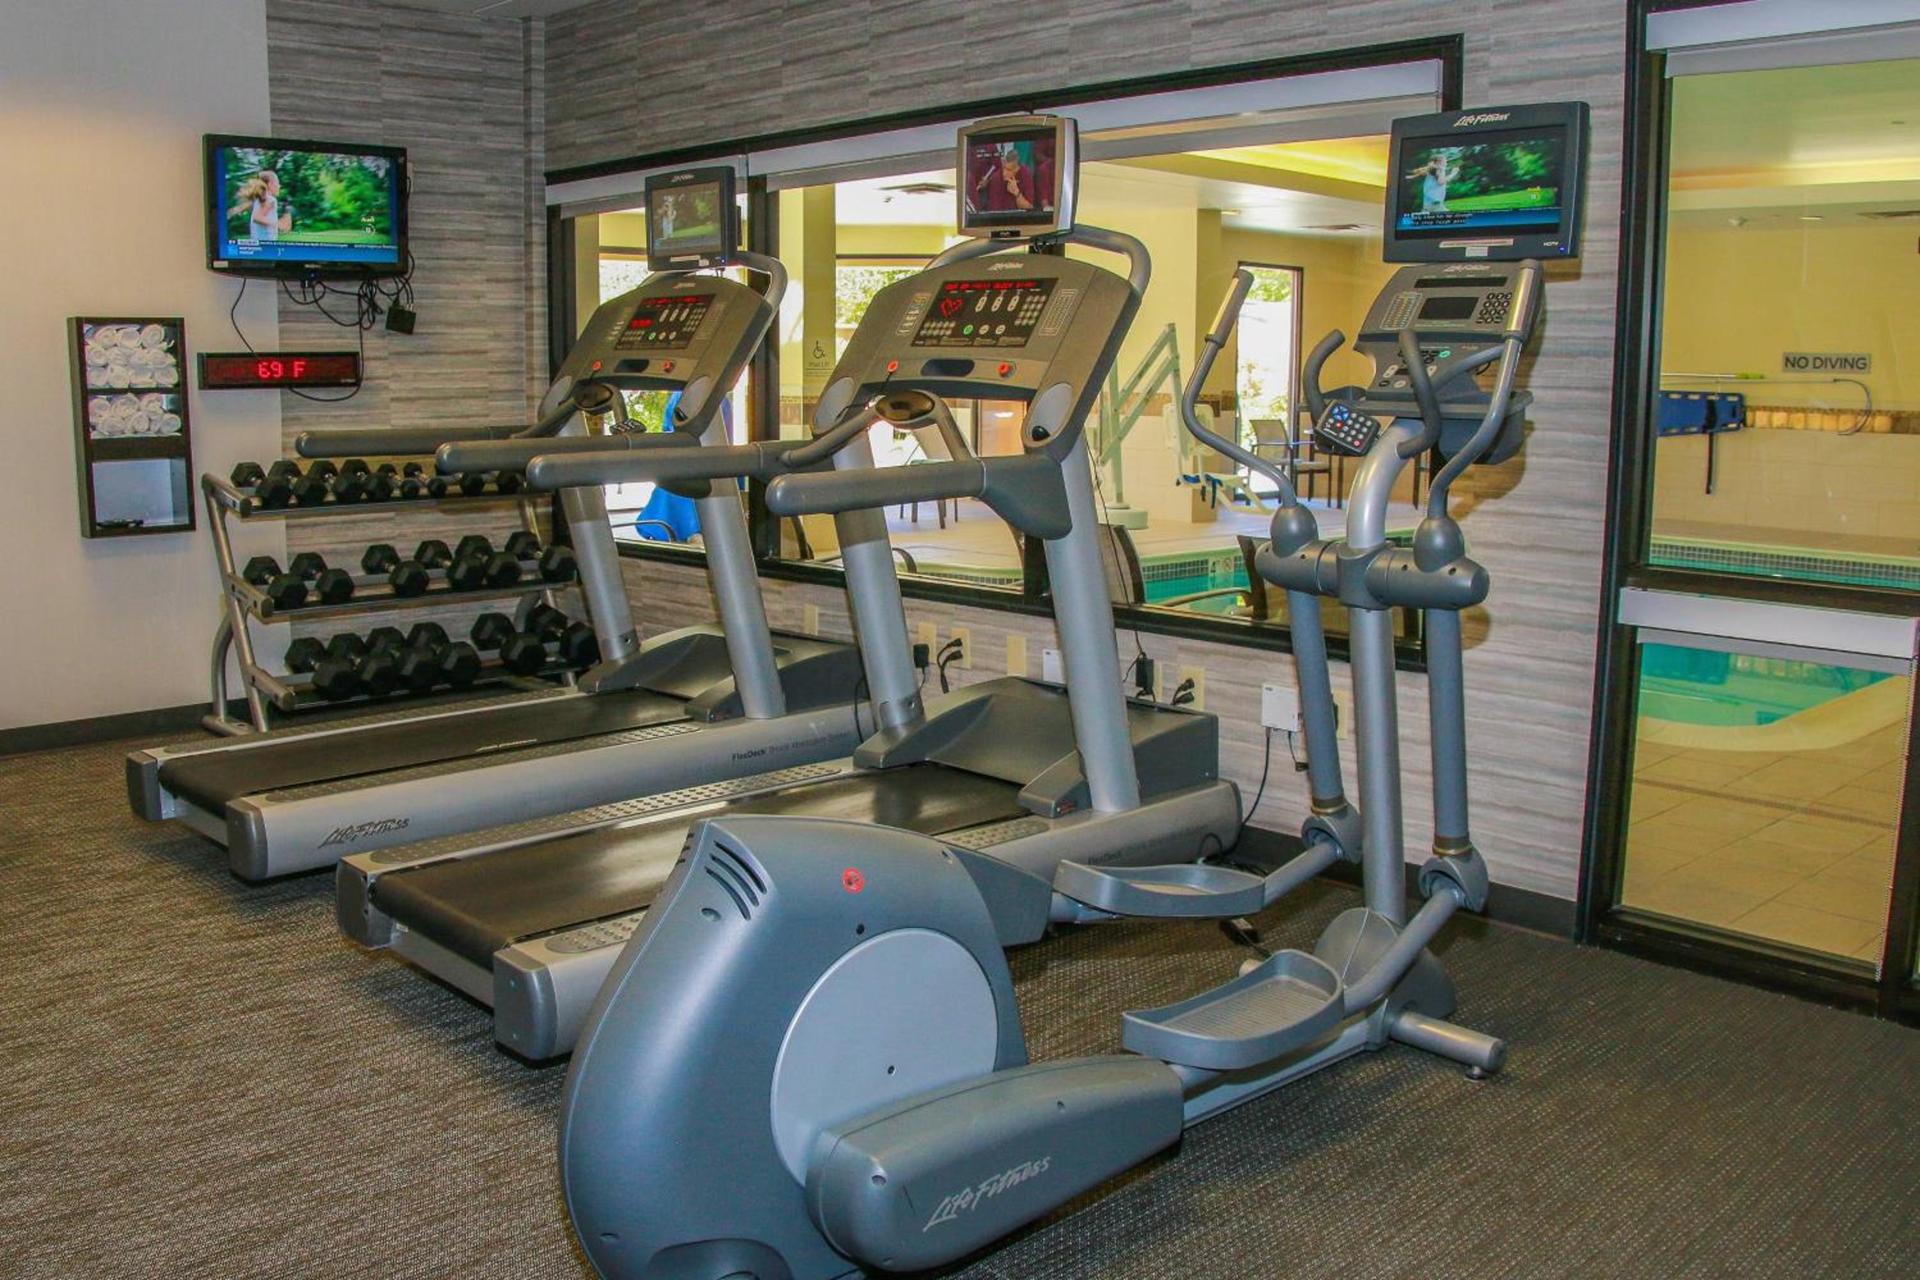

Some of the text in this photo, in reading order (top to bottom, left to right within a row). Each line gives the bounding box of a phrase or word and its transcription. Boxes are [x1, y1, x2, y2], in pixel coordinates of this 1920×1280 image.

[257, 360, 308, 380] 69 F
[1784, 355, 1868, 371] NO DIVING
